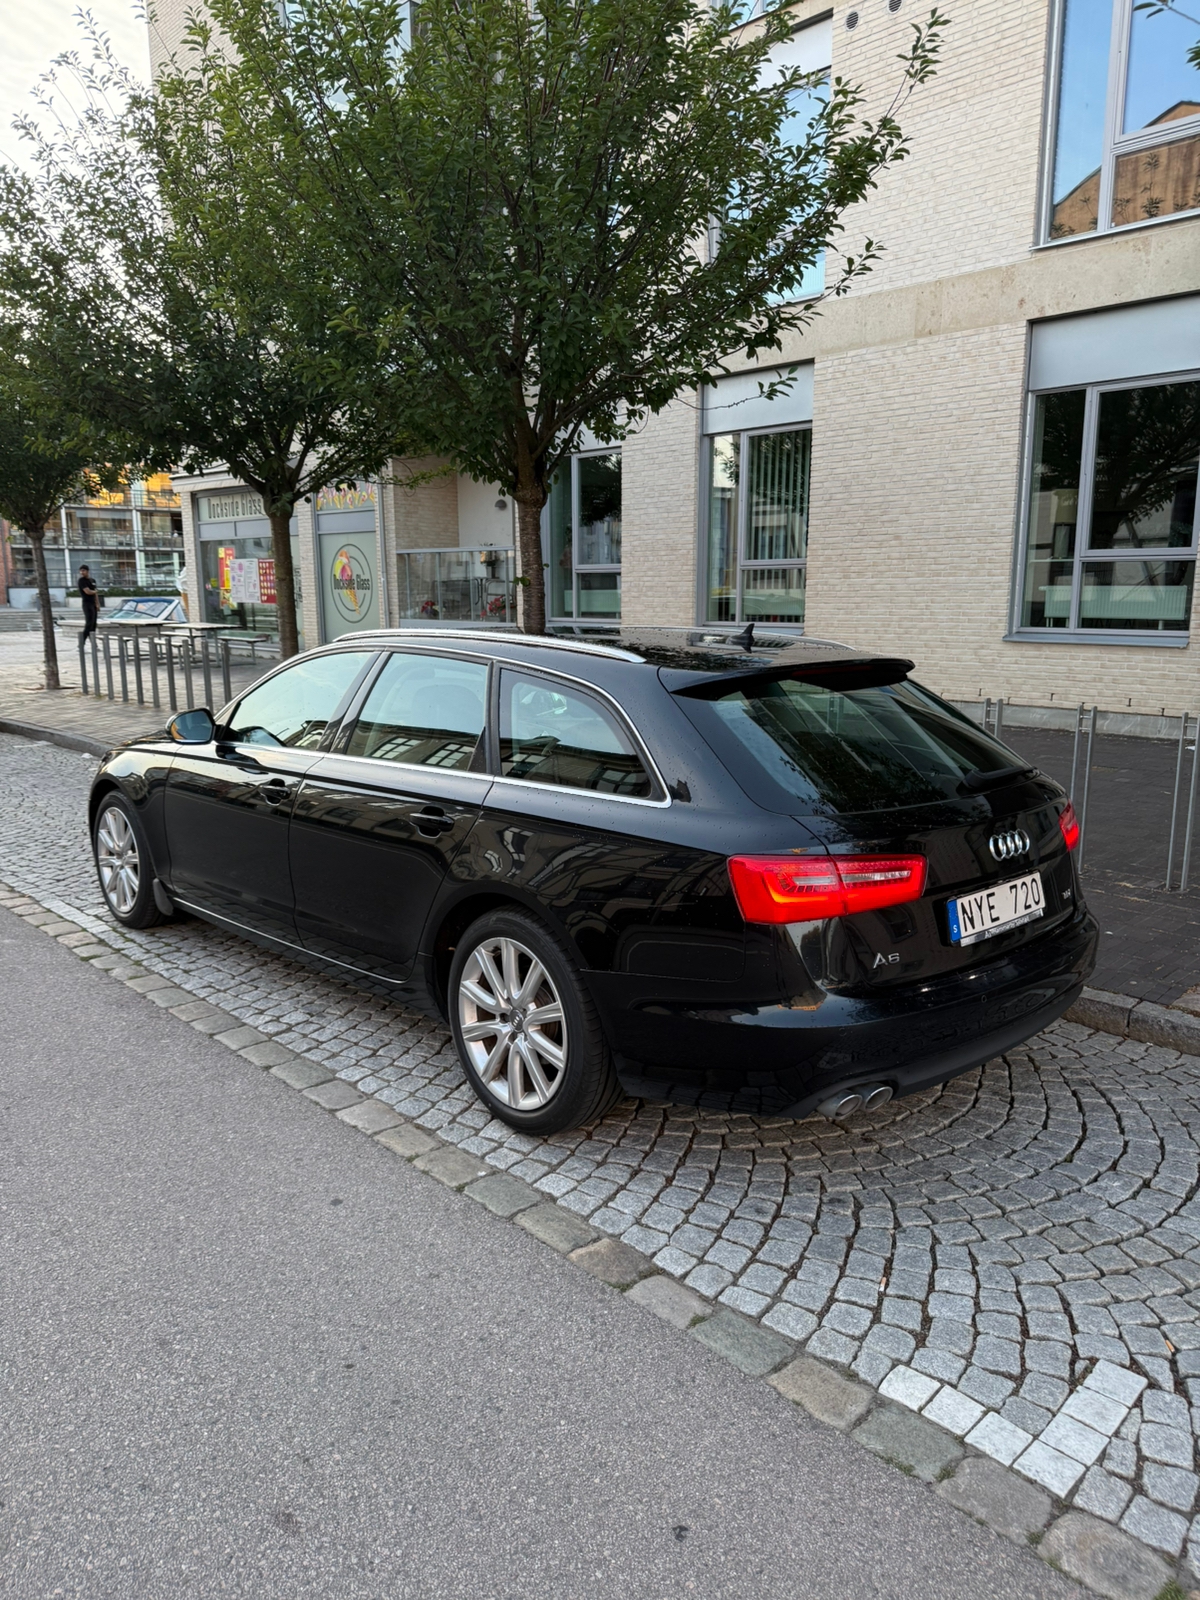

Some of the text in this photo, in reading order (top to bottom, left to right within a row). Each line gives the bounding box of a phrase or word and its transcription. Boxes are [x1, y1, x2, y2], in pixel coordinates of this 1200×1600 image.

[961, 892, 1000, 932] NYE
[1009, 879, 1041, 914] 720
[953, 924, 958, 933] S
[873, 952, 900, 969] A6
